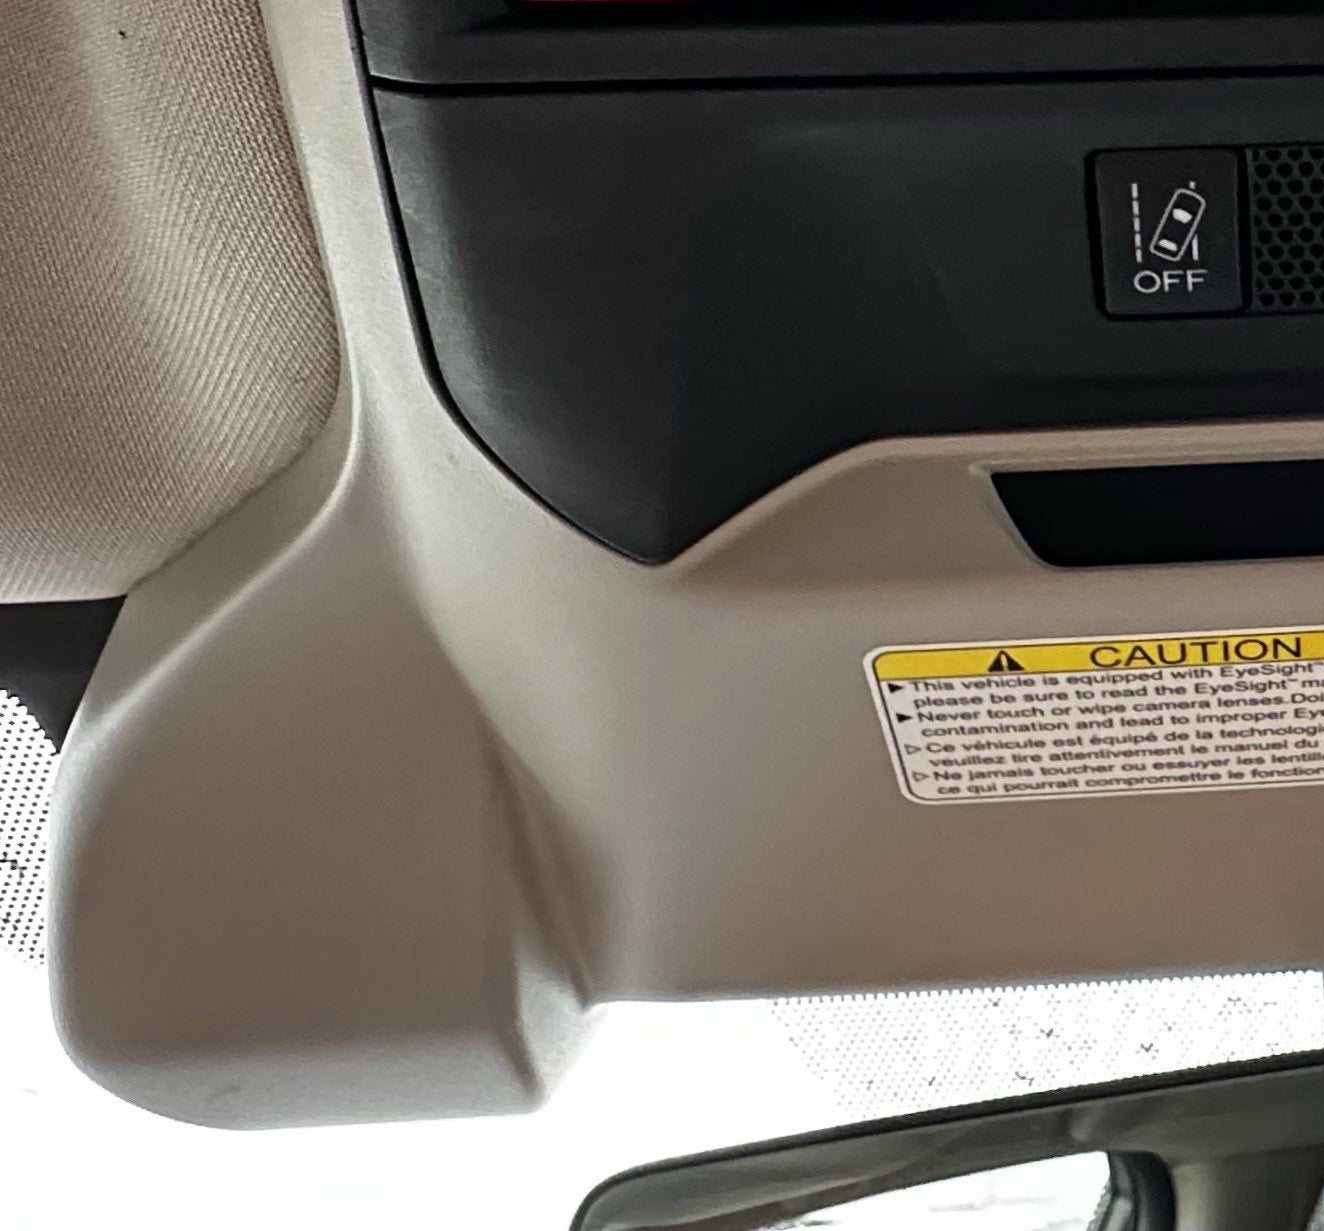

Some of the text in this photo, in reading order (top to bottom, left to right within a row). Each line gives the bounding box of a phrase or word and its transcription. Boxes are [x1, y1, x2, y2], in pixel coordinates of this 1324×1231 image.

[1133, 268, 1208, 294] OFF
[1090, 636, 1301, 668] CAUTION
[911, 681, 955, 693] This
[962, 675, 1036, 689] vehicle
[1042, 674, 1059, 686] is
[1066, 670, 1163, 686] equipped
[1171, 668, 1213, 680] with
[913, 693, 984, 709] please
[990, 693, 1017, 705] be
[1022, 692, 1069, 704] sure
[1075, 688, 1095, 701] to
[1101, 686, 1148, 699] read
[1154, 684, 1187, 697] the
[917, 709, 980, 723] Never
[987, 705, 1045, 719] touch
[1051, 704, 1072, 716] or
[1079, 702, 1127, 718] wipe
[1132, 699, 1211, 713] camera
[921, 720, 1069, 738] contamination
[1075, 717, 1114, 730] and
[1119, 714, 1163, 728] lead
[1170, 714, 1190, 726] to
[1196, 709, 1287, 726] improper
[925, 741, 956, 754] Ce
[1052, 735, 1084, 748] est
[1163, 730, 1190, 743] de
[1195, 728, 1213, 741] la
[1215, 738, 1288, 753] manuel
[1294, 737, 1319, 750] du
[933, 769, 963, 782] Ne
[968, 766, 1035, 782] jamais
[1040, 762, 1116, 777] toucher
[1121, 760, 1147, 772] ou
[1152, 756, 1230, 772] essuyer
[937, 783, 961, 796] ce
[966, 780, 998, 796] qui
